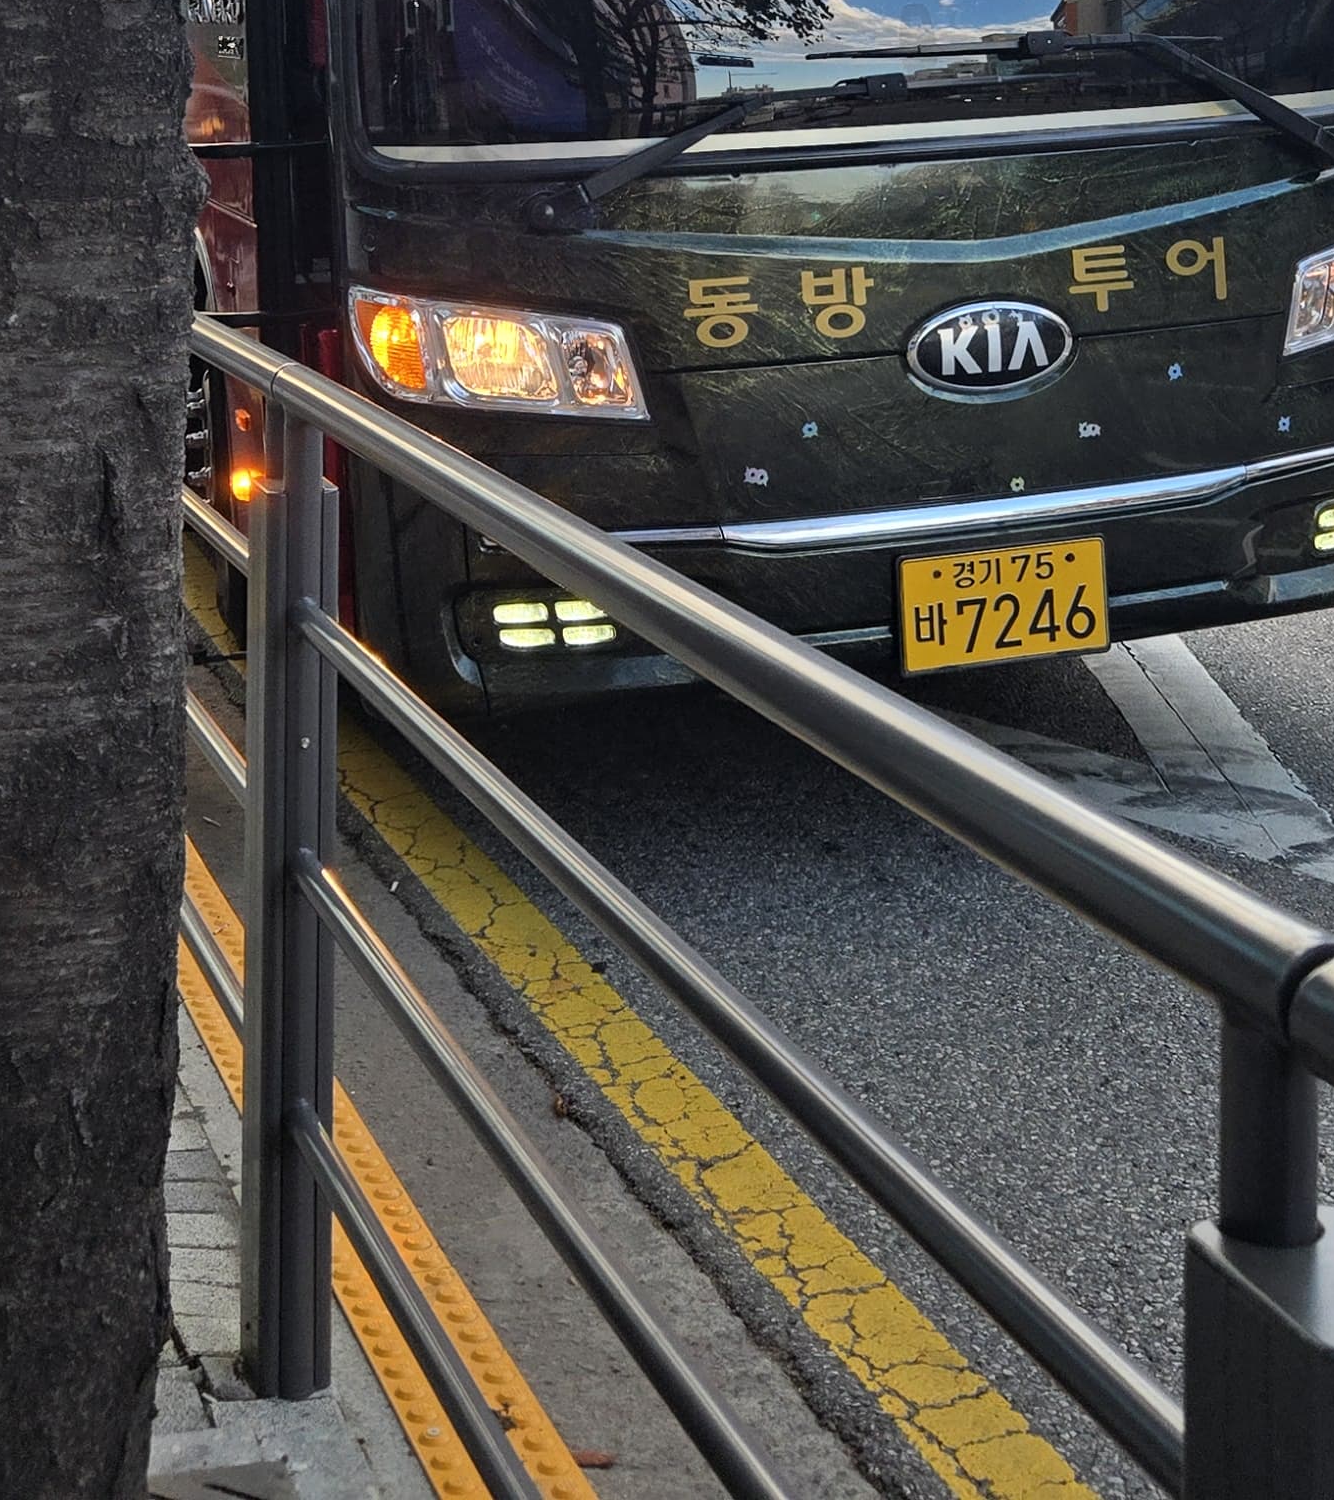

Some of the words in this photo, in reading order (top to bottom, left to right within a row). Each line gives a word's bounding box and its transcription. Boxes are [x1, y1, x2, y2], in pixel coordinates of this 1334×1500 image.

[937, 318, 1050, 376] KIA
[953, 559, 1002, 589] 경기
[1010, 551, 1054, 583] 75
